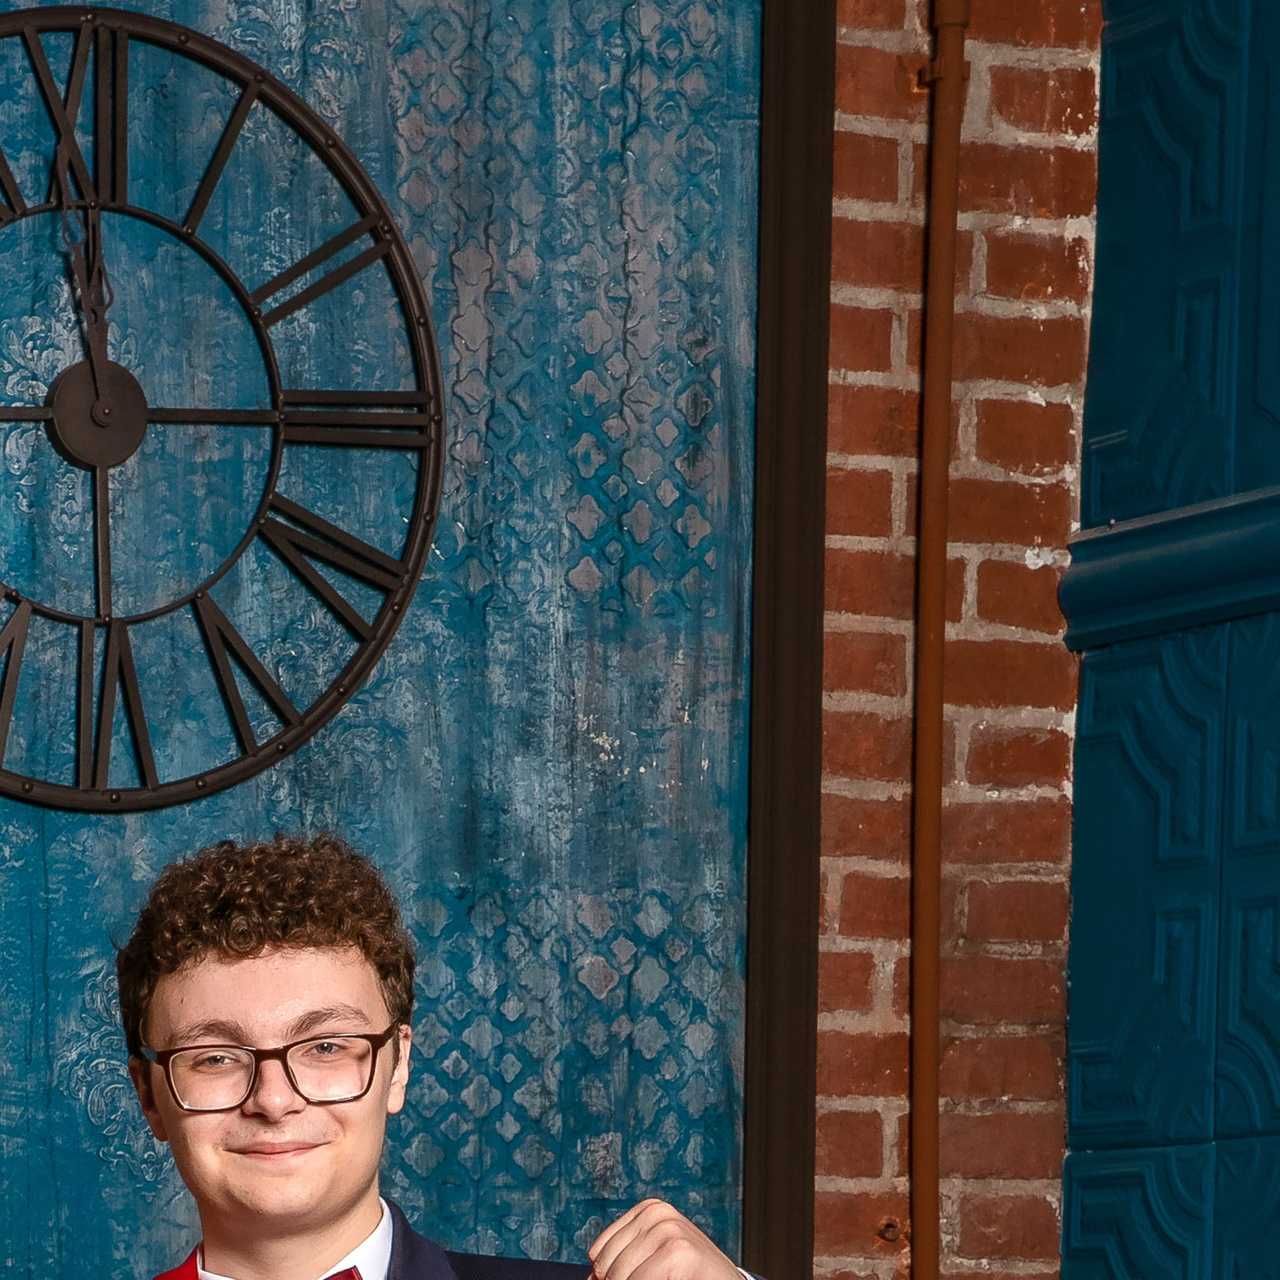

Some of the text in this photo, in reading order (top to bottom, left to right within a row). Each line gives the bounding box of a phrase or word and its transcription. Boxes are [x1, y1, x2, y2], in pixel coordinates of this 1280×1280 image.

[23, 20, 128, 206] XII
[187, 76, 260, 234] I
[251, 212, 395, 326] II
[281, 388, 437, 449] III
[260, 494, 408, 641] IV
[77, 617, 158, 795] VI
[196, 592, 304, 756] V
